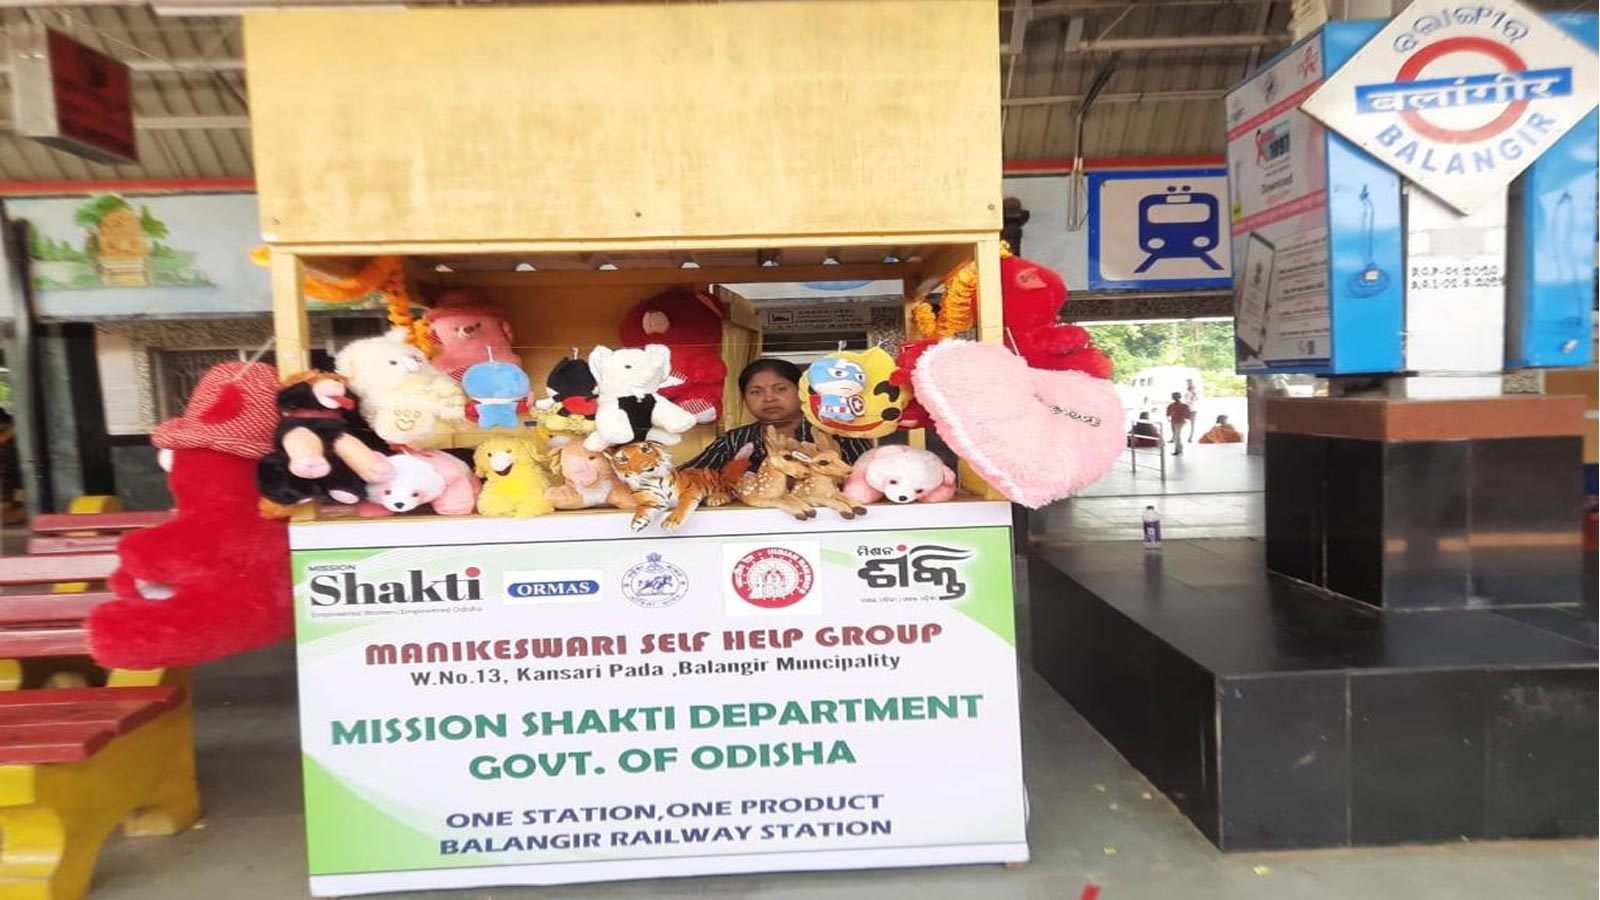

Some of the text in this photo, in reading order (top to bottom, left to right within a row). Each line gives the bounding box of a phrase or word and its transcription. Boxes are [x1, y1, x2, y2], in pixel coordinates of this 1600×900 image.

[1366, 74, 1562, 110] बलांगीर
[1375, 111, 1556, 175] BALANGIR
[308, 564, 356, 572] MISSION
[856, 545, 894, 556] ମିଶନ
[310, 566, 483, 607] Shakti
[516, 581, 591, 597] ORMAS
[857, 545, 974, 600] ଶକ୍ତି
[365, 623, 943, 666] MANIKESWARI SELF HELP GROUP
[410, 669, 508, 686] W.No.13,
[517, 666, 602, 682] Kansari
[609, 662, 664, 678] Pada
[776, 653, 901, 672] Muncipality
[331, 694, 984, 746] MISSION SHAKTI DEPARTMENT
[469, 740, 857, 780] GOVT. OF ODISHA
[446, 811, 513, 829] ONE
[741, 794, 885, 815] PRODUCT
[440, 820, 893, 855] BALANGIR RAILWAY STATION
